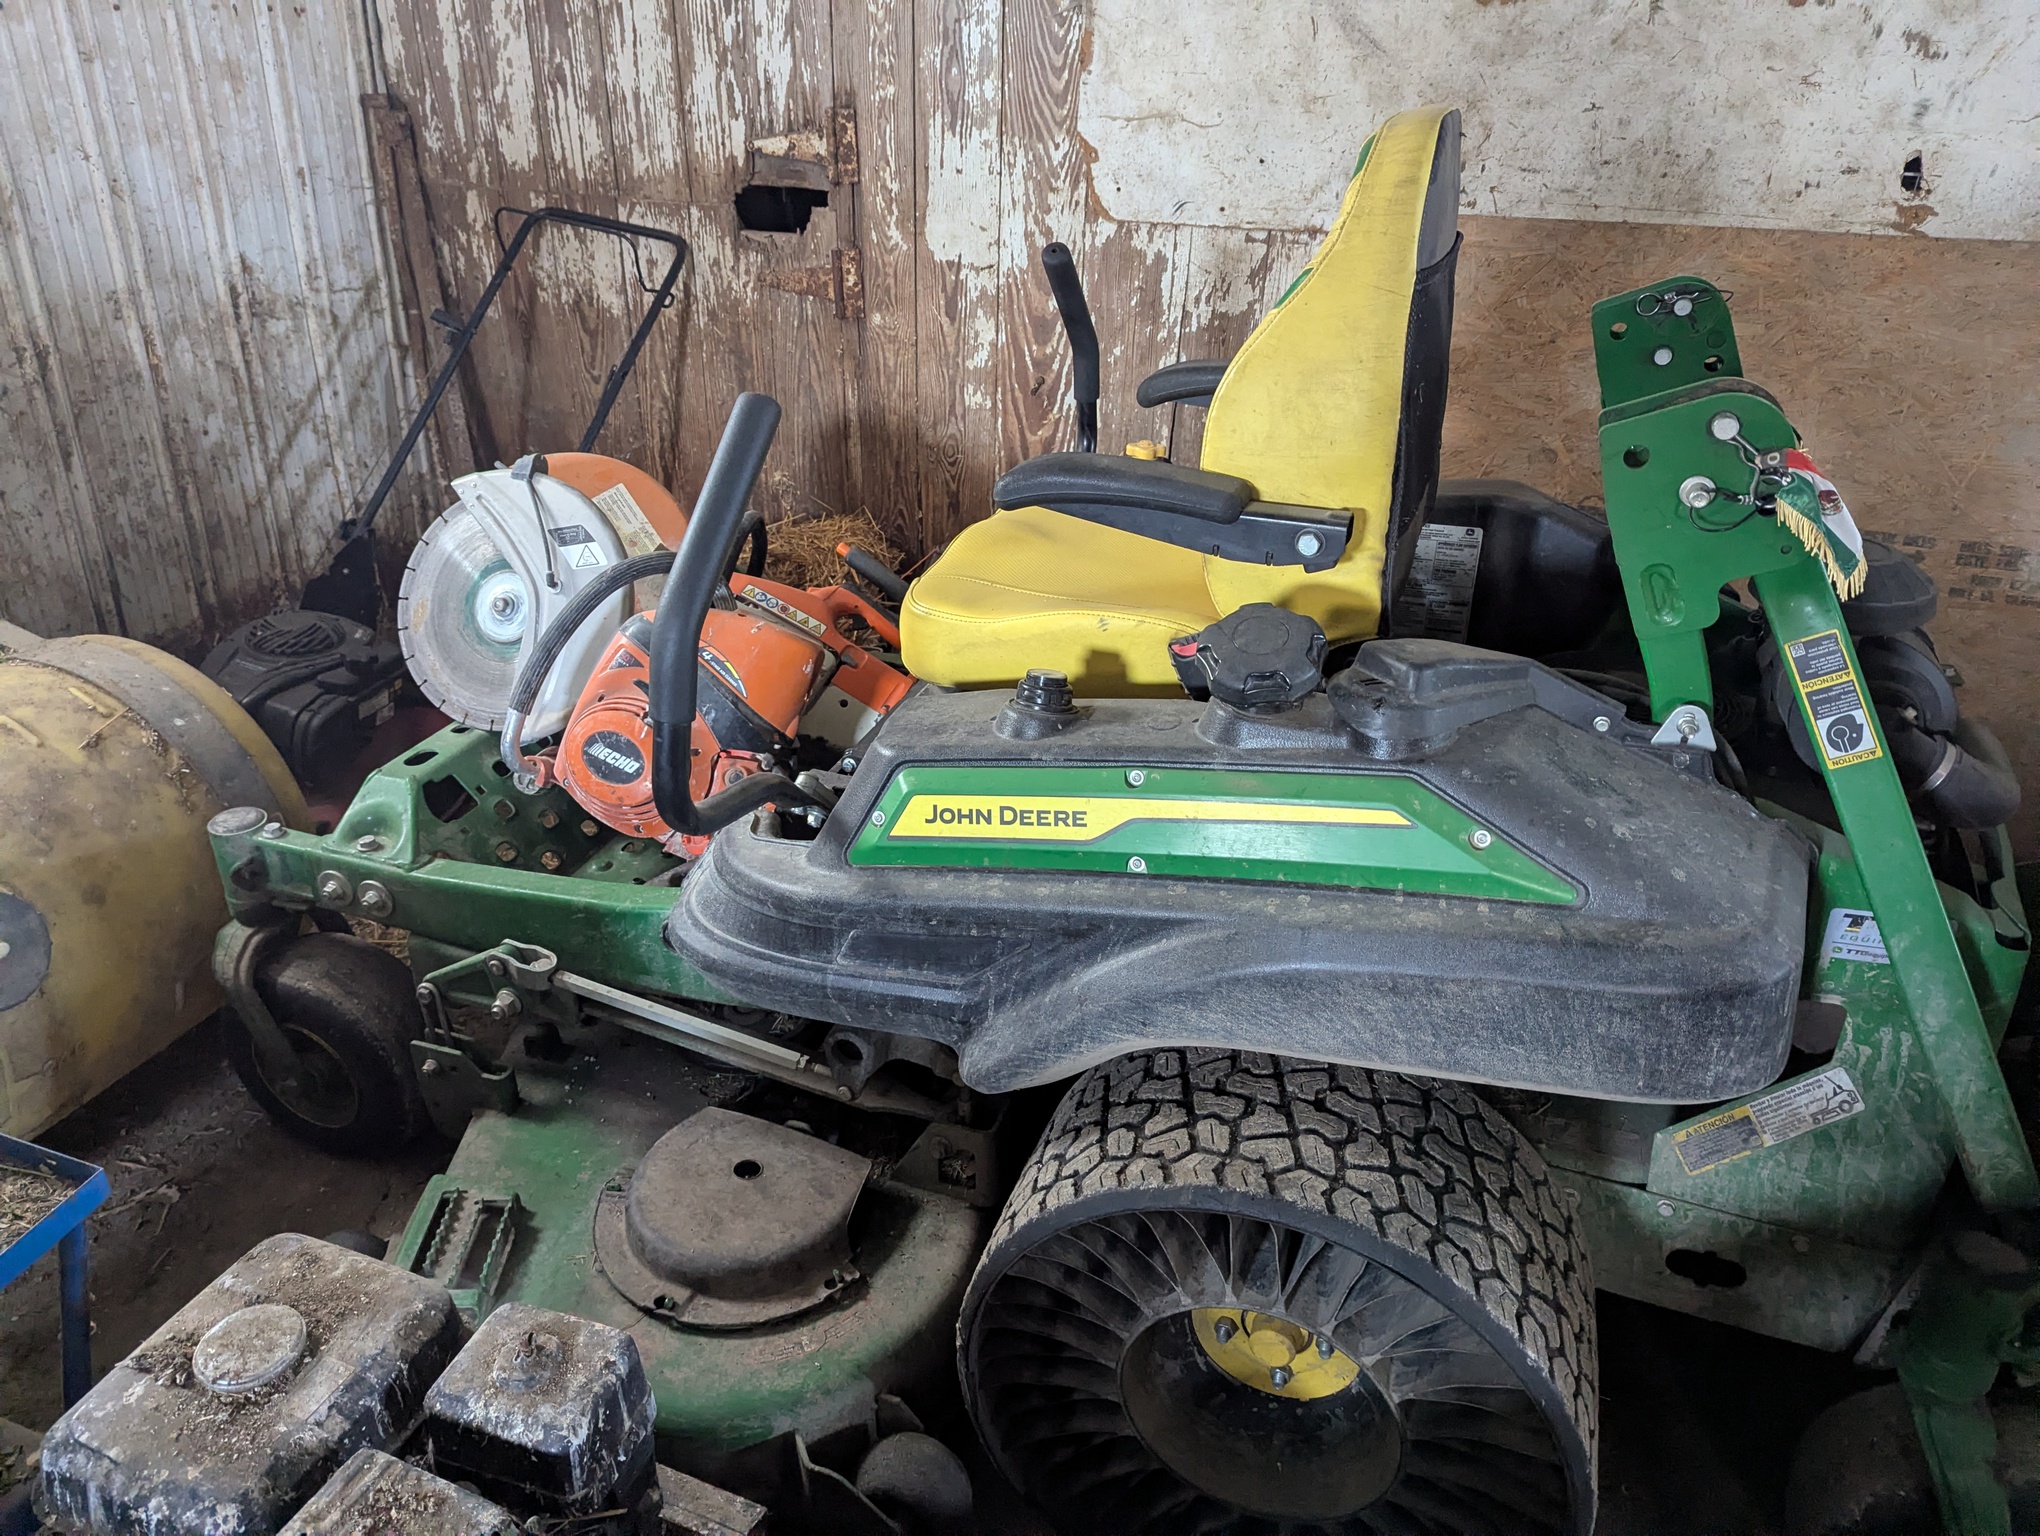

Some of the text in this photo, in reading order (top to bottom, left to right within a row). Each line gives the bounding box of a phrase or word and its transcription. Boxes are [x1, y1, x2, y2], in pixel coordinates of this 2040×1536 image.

[1801, 673, 1844, 691] ATENCIÓN
[597, 746, 640, 774] ECHO
[1832, 752, 1870, 766] CAUTION
[925, 804, 1087, 828] JOHN DEERE
[1692, 1112, 1735, 1135] ATENCIÓN
